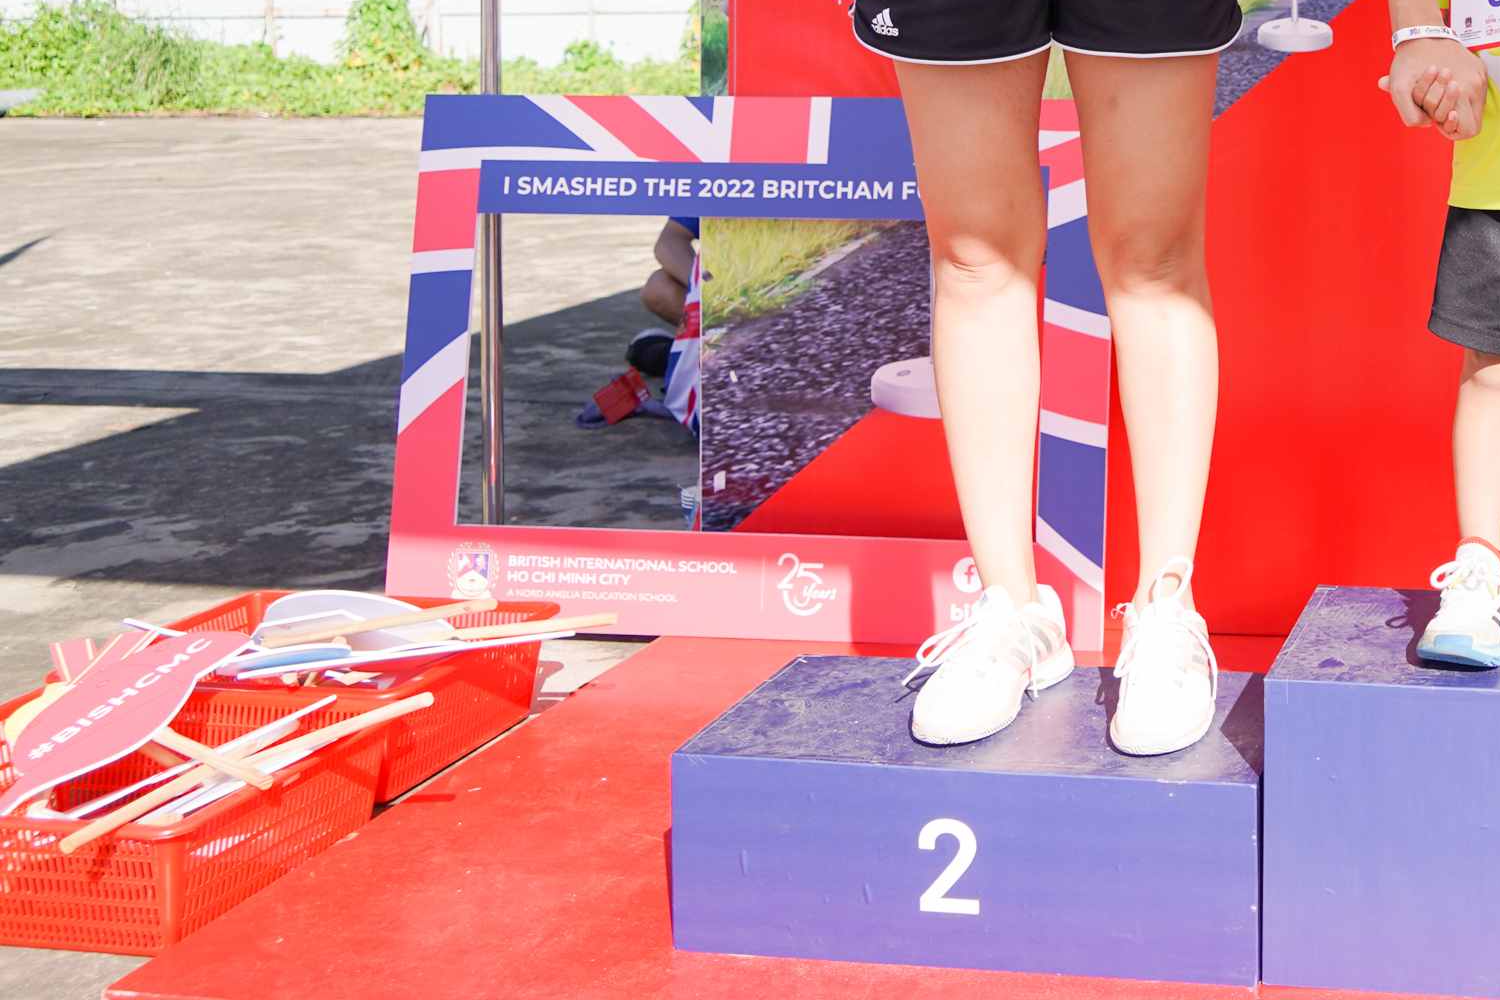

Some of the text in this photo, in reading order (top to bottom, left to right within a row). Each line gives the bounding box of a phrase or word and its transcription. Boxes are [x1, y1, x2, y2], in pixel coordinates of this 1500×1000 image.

[503, 176, 510, 194] I
[517, 176, 637, 197] SMASHED
[643, 177, 691, 197] THE
[698, 178, 755, 198] 2022
[763, 179, 893, 200] BRITCHAM
[507, 571, 631, 585] HO CHI MINH CITY
[508, 555, 737, 574] BRITISH INTERNATIONAL SCHOOL
[777, 552, 824, 616] 25
[28, 637, 212, 760] #BISHCMC
[918, 818, 981, 916] 2
